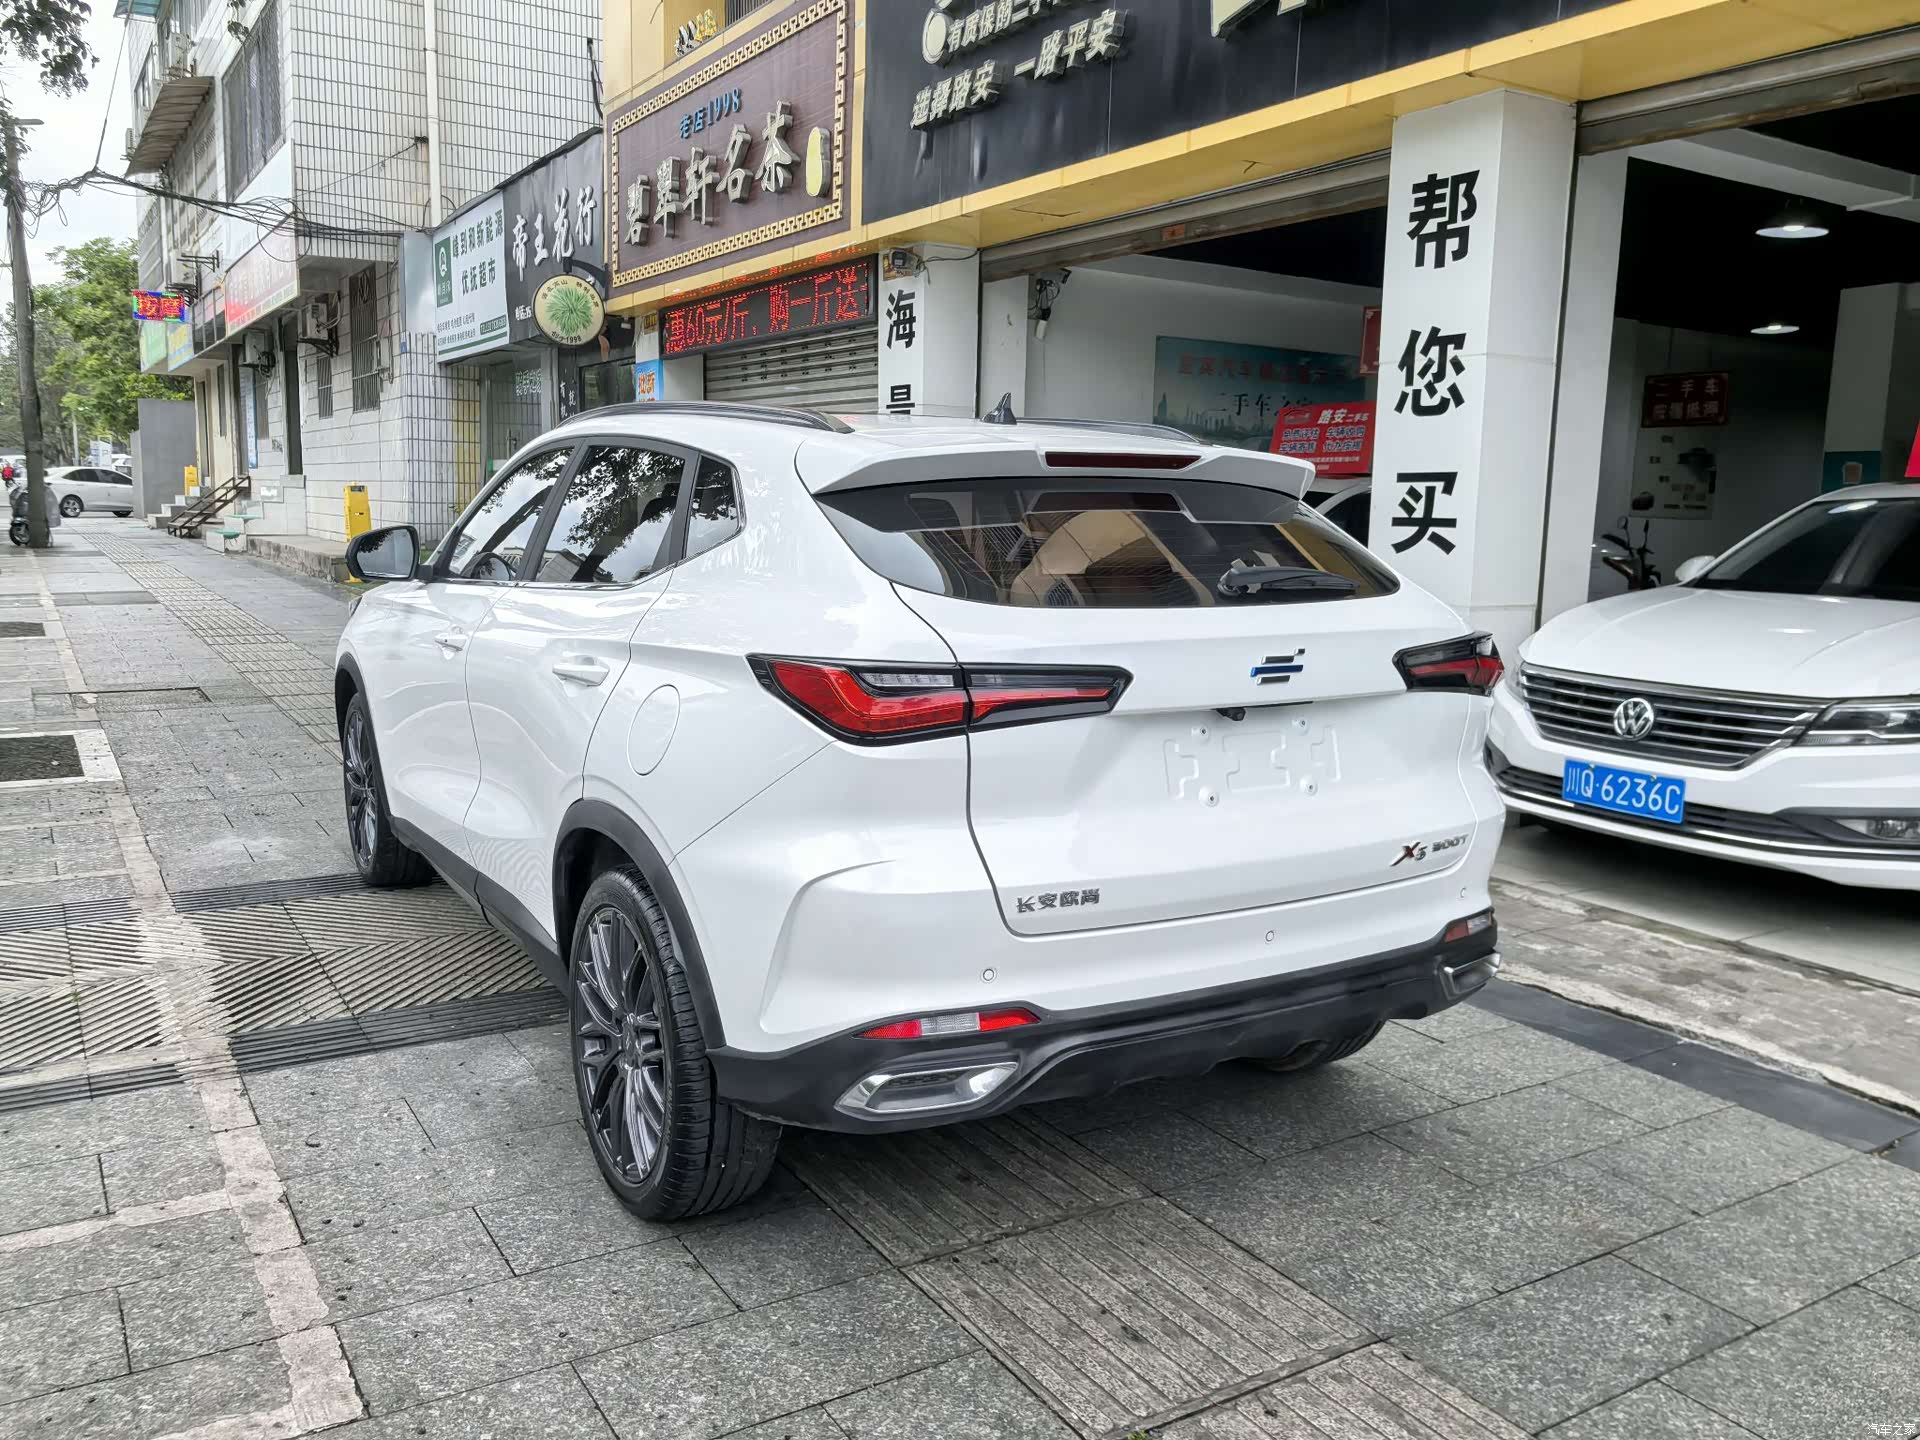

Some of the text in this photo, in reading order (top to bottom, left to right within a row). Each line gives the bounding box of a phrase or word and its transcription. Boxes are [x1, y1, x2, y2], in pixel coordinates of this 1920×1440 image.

[1014, 8, 1120, 80] 一路平安
[679, 87, 742, 140] 老店1998
[1391, 169, 1481, 556] 帮您买
[1016, 888, 1100, 914] 长安欧尚
